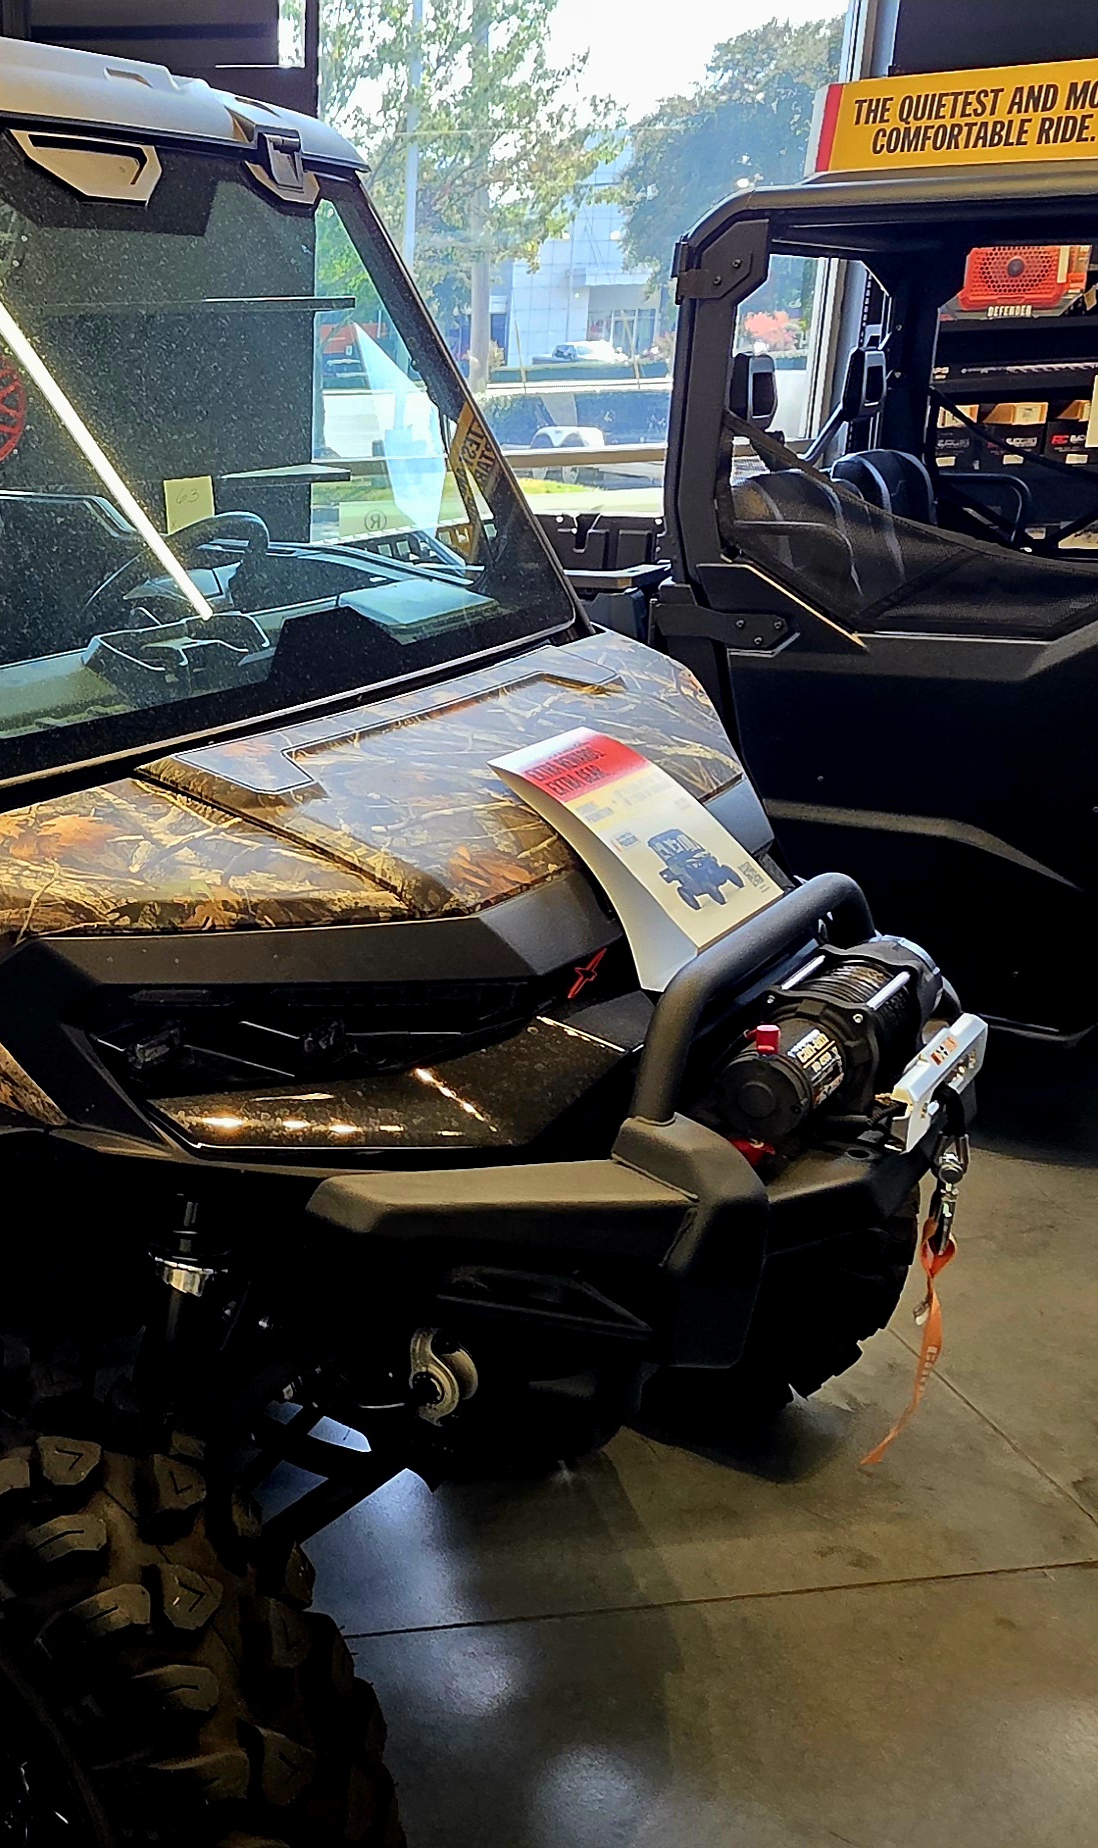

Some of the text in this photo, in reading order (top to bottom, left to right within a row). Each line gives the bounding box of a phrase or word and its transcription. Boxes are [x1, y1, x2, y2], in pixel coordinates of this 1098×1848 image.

[854, 97, 894, 125] THE
[898, 88, 1004, 124] QUIETEST
[1007, 84, 1058, 115] AND
[872, 114, 1096, 154] COMFORTABLE RIDE.
